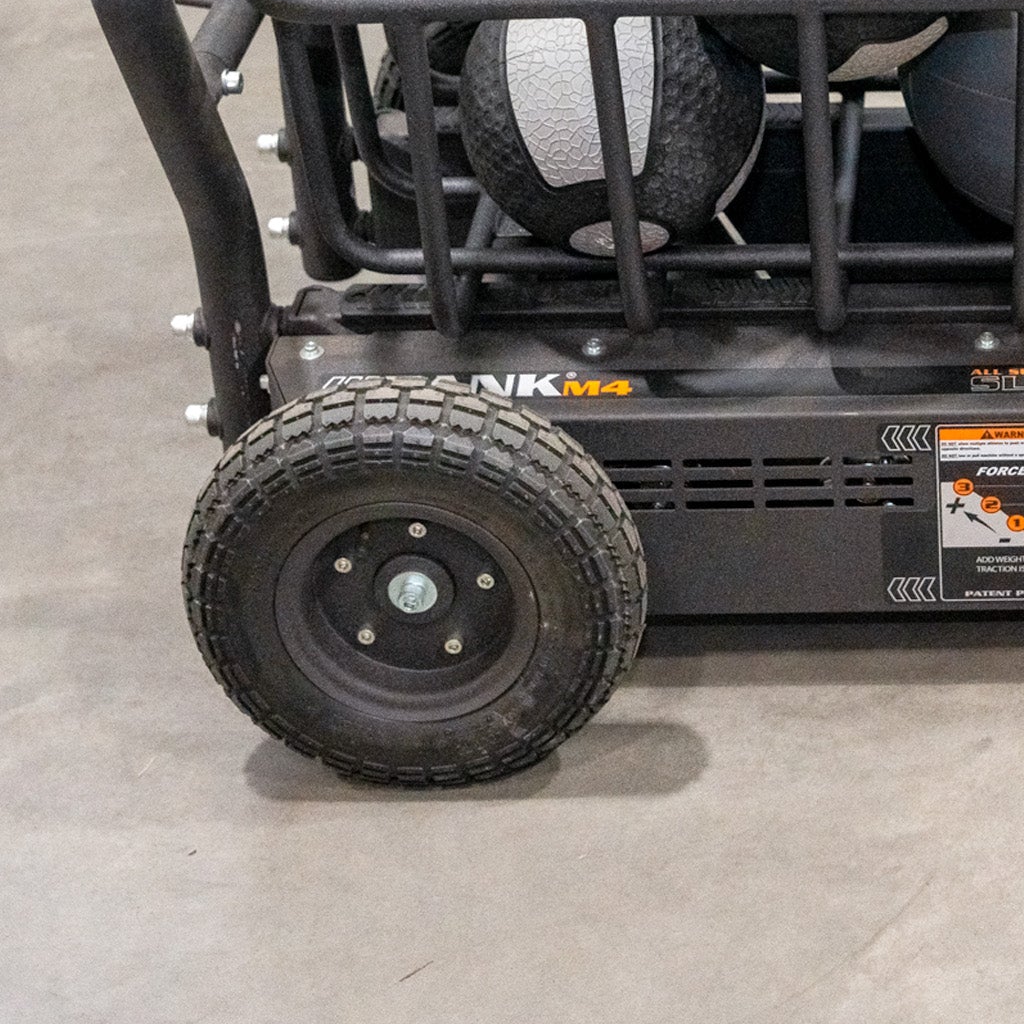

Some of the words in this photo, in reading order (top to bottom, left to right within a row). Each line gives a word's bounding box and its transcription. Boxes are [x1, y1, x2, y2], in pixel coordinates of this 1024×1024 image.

[970, 368, 1001, 376] ALL
[563, 380, 633, 397] M4
[960, 482, 970, 492] 3
[985, 499, 998, 510] 2
[976, 556, 994, 564] ADD
[976, 565, 1017, 573] TRACTION
[964, 589, 1012, 597] PATENT
